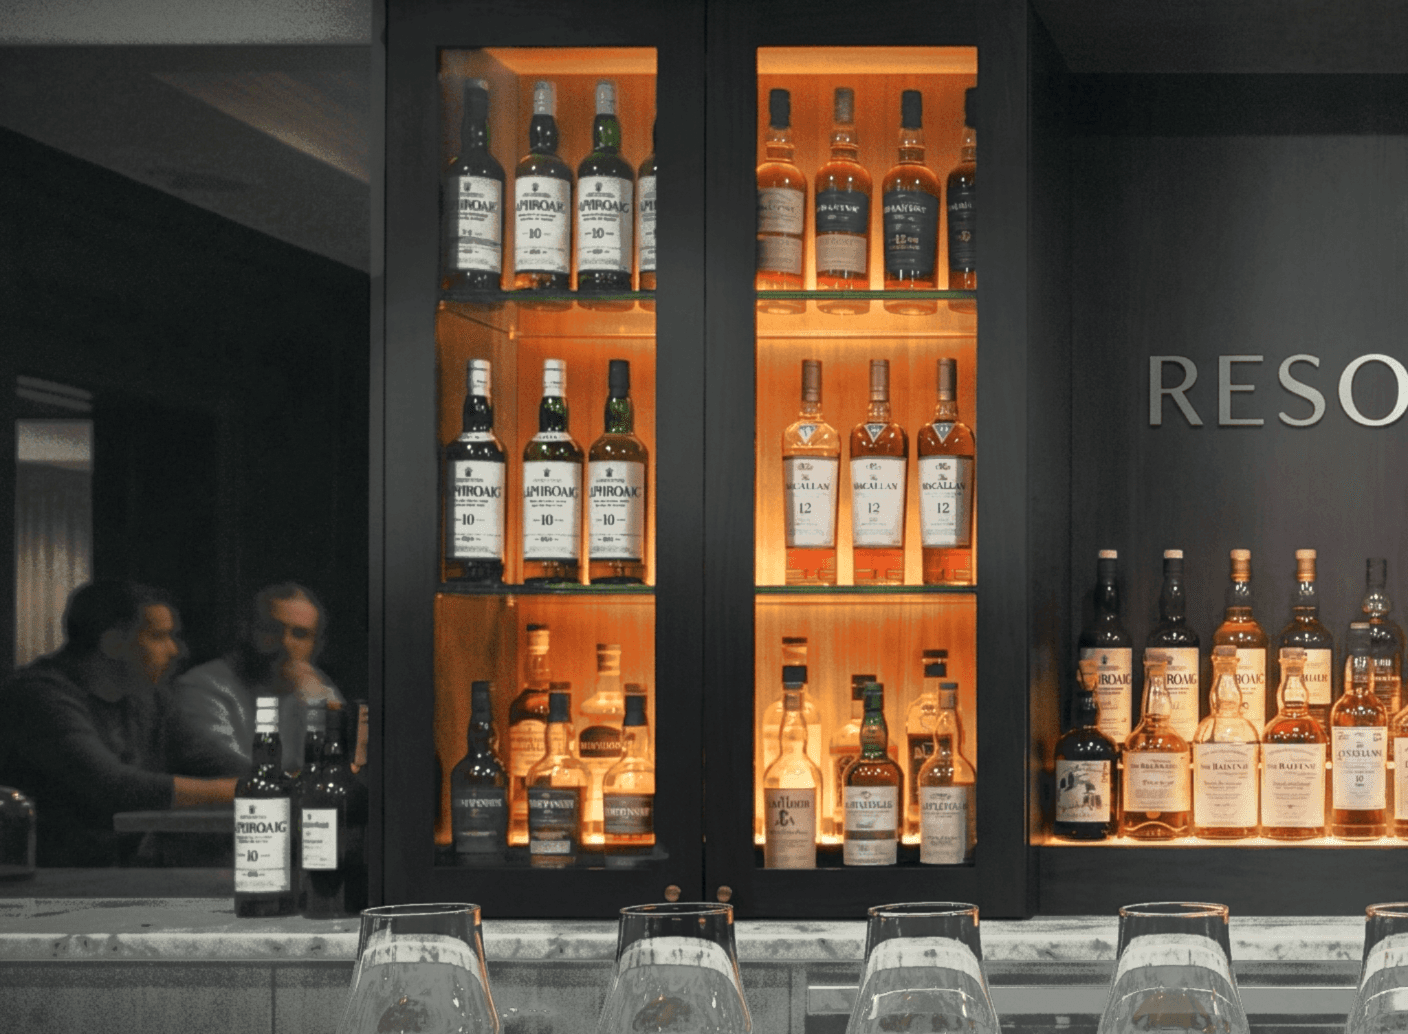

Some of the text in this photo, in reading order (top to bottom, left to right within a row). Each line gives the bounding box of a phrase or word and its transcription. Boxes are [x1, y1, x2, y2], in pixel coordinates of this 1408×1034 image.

[799, 502, 811, 514] 12
[868, 502, 880, 514] 12
[937, 502, 950, 514] 12
[462, 513, 475, 526] 10
[541, 513, 554, 526] 10
[603, 513, 616, 526] 10
[247, 849, 259, 862] 10
